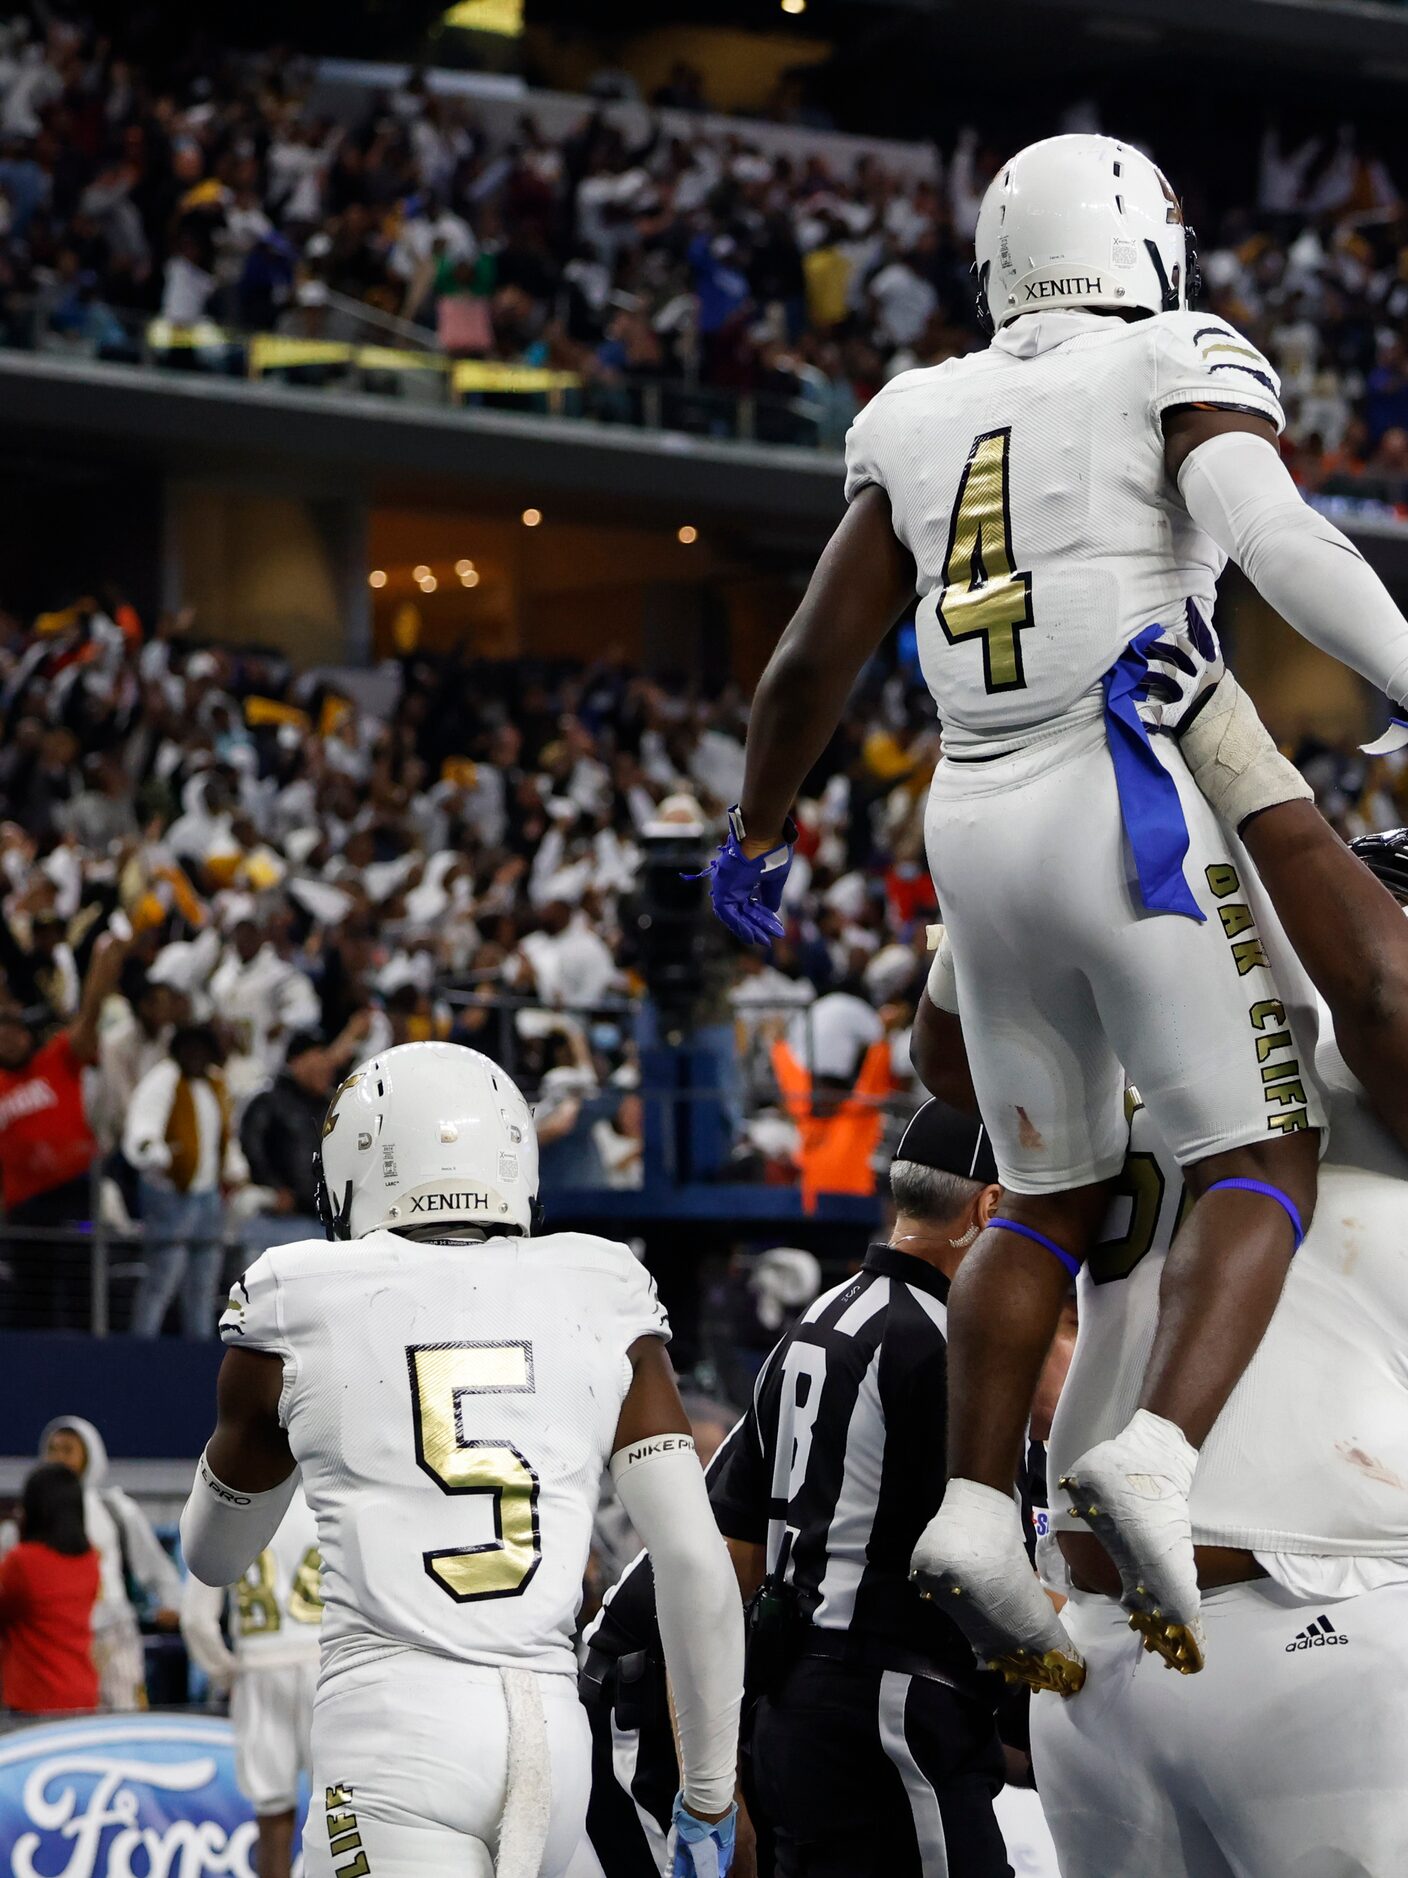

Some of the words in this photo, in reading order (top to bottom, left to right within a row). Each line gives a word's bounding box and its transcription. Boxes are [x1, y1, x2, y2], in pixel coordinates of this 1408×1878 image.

[1024, 277, 1103, 301] XENITH
[936, 426, 1035, 695] 4
[1204, 863, 1271, 977] OAK
[1248, 998, 1309, 1133] CLIFF
[409, 1193, 489, 1213] XENITH
[628, 1439, 676, 1464] NIKE
[404, 1339, 543, 1604] 5
[208, 1481, 251, 1505] PRO
[1285, 1633, 1349, 1652] adidas
